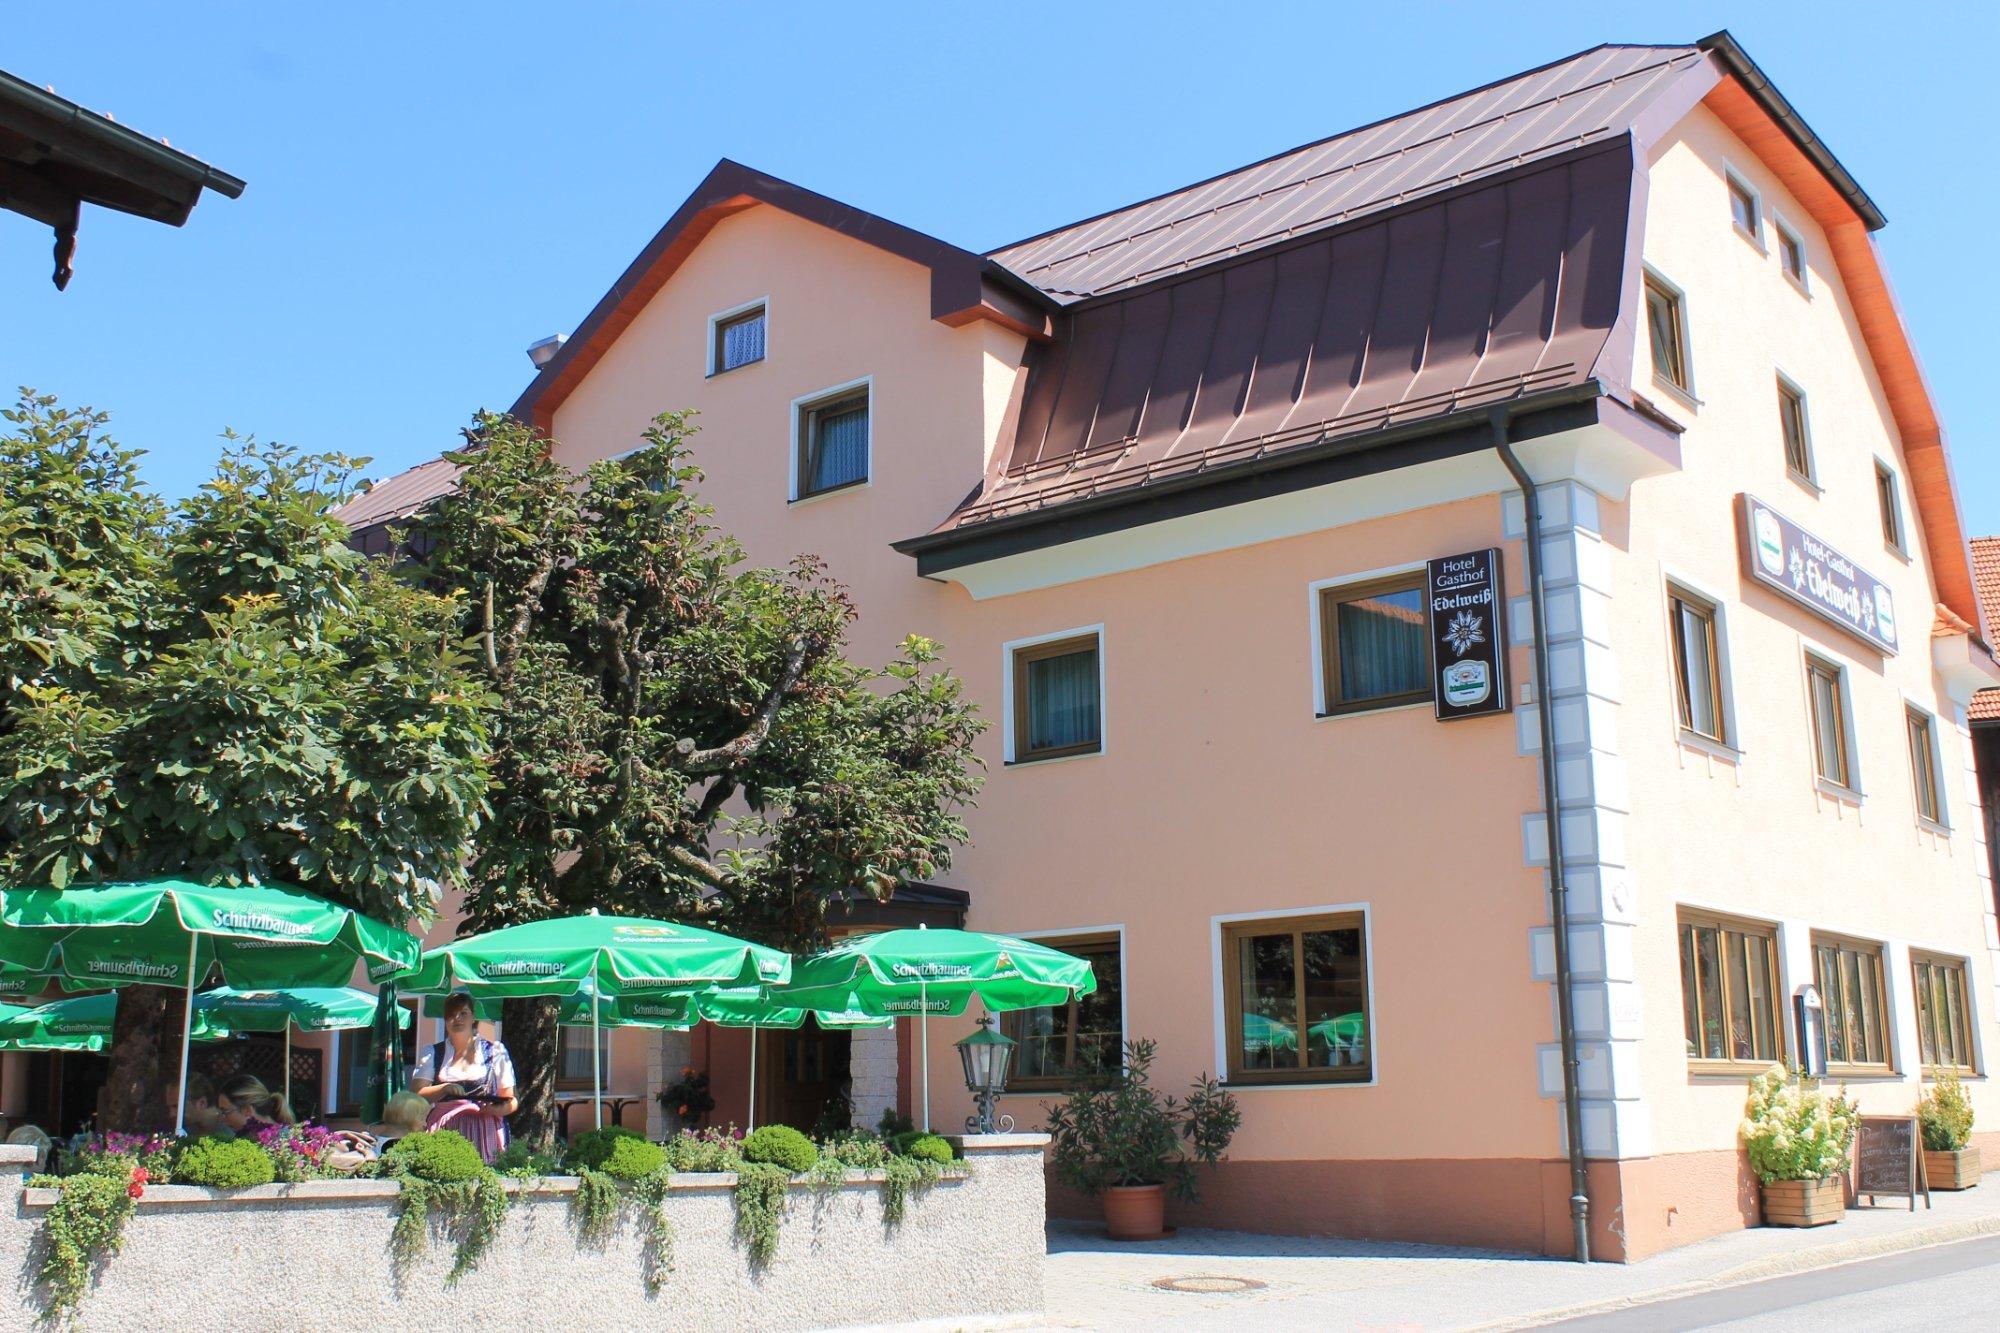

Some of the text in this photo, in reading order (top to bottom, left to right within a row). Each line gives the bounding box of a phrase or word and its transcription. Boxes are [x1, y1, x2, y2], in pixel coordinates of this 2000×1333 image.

[1443, 556, 1476, 574] Hotel
[1436, 567, 1485, 587] Gasthof
[1432, 588, 1492, 611] Edelweiß
[213, 908, 316, 935] Schnitzlbaumer
[479, 960, 566, 977] Schnitzlbaumer
[892, 963, 972, 978] Schnitzlbaumer
